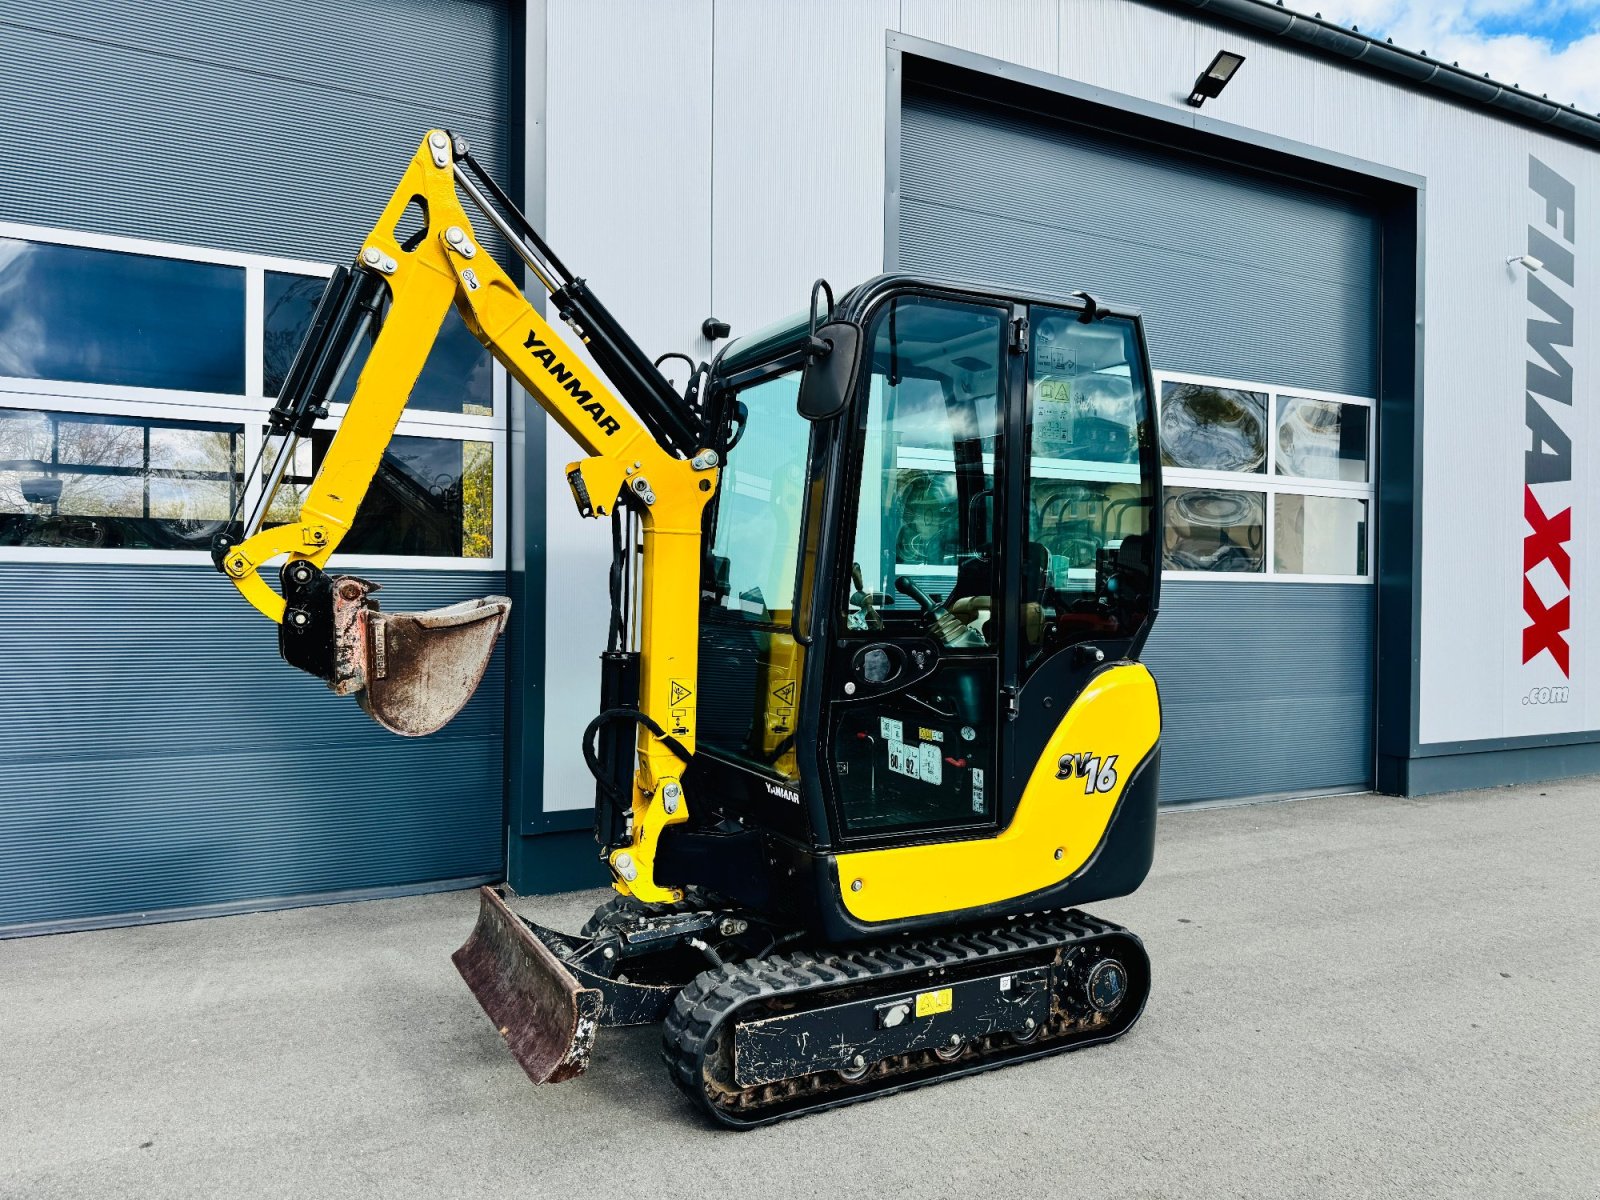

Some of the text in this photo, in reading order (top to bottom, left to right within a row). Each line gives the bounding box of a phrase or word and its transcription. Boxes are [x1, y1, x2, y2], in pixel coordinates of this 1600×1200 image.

[523, 329, 621, 436] YANMAR
[1522, 153, 1576, 680] FIMAXX
[1522, 686, 1569, 705] .com
[905, 758, 915, 775] 92
[1055, 752, 1119, 795] SV16
